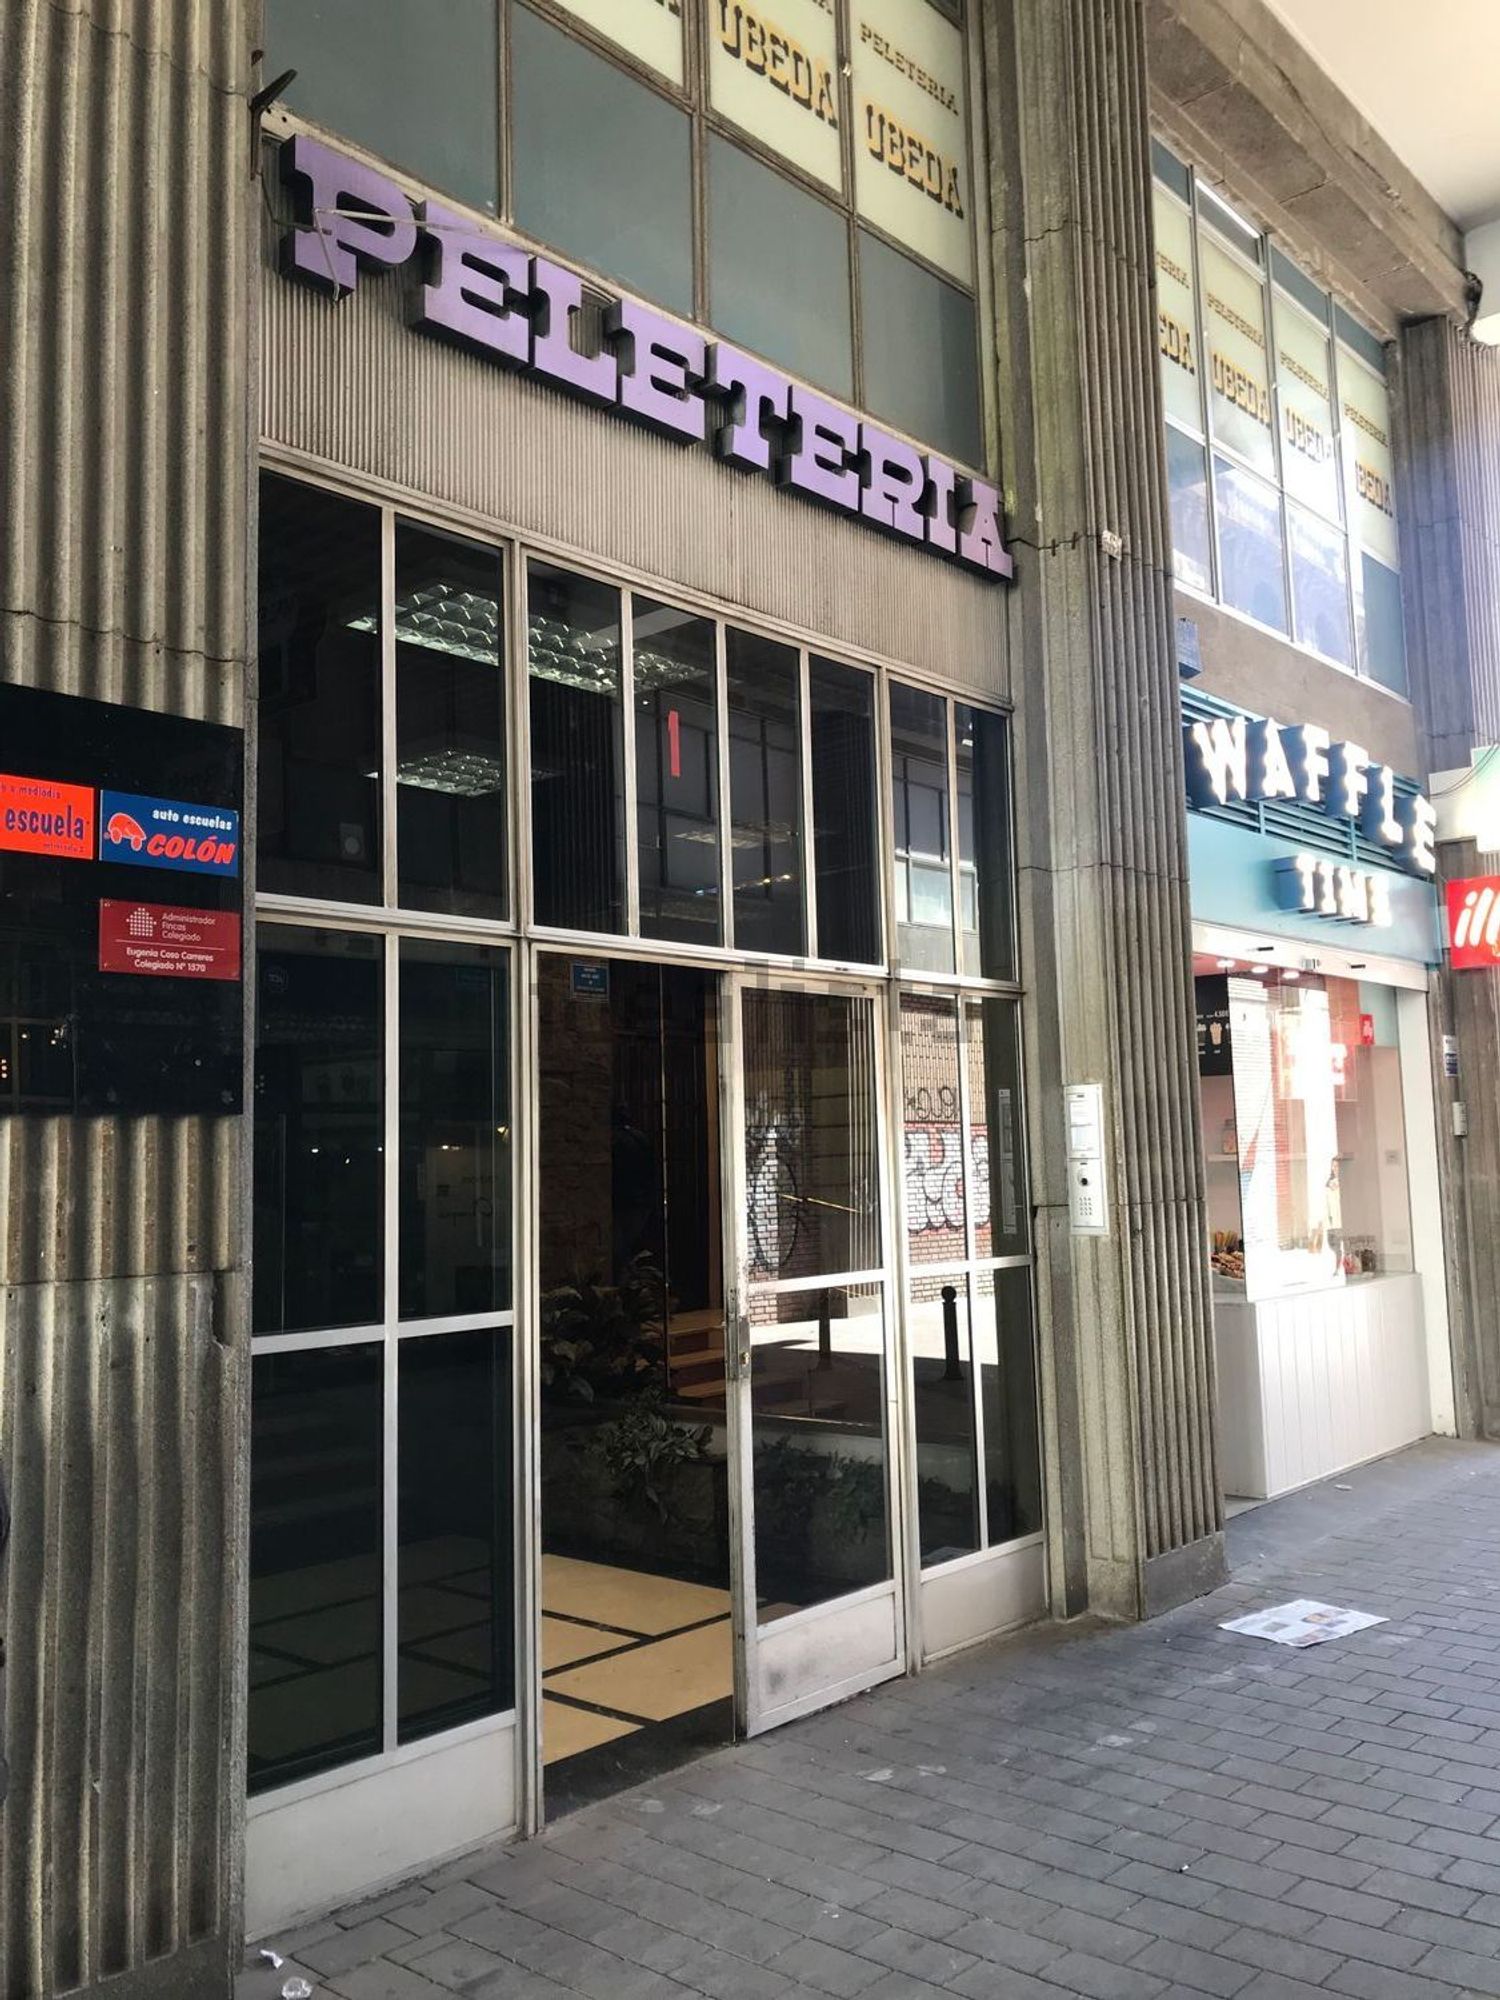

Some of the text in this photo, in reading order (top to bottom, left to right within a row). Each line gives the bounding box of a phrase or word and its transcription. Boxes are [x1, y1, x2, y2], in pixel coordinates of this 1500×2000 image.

[714, 0, 838, 129] UBEDA
[860, 21, 960, 117] PELETERIA
[862, 97, 964, 219] UBEDA
[279, 133, 1015, 581] PELETERIA
[1211, 348, 1272, 431] UBEDA
[5, 804, 85, 841] escuela
[152, 808, 233, 831] auto escuelas
[1186, 716, 1437, 876] WAFFLE
[146, 833, 237, 865] COLÓN
[1294, 851, 1393, 927] TIME
[161, 912, 216, 926] Administrador
[161, 930, 202, 942] Colegiado
[126, 947, 159, 959] Eugenia
[134, 959, 175, 971] Colegiado
